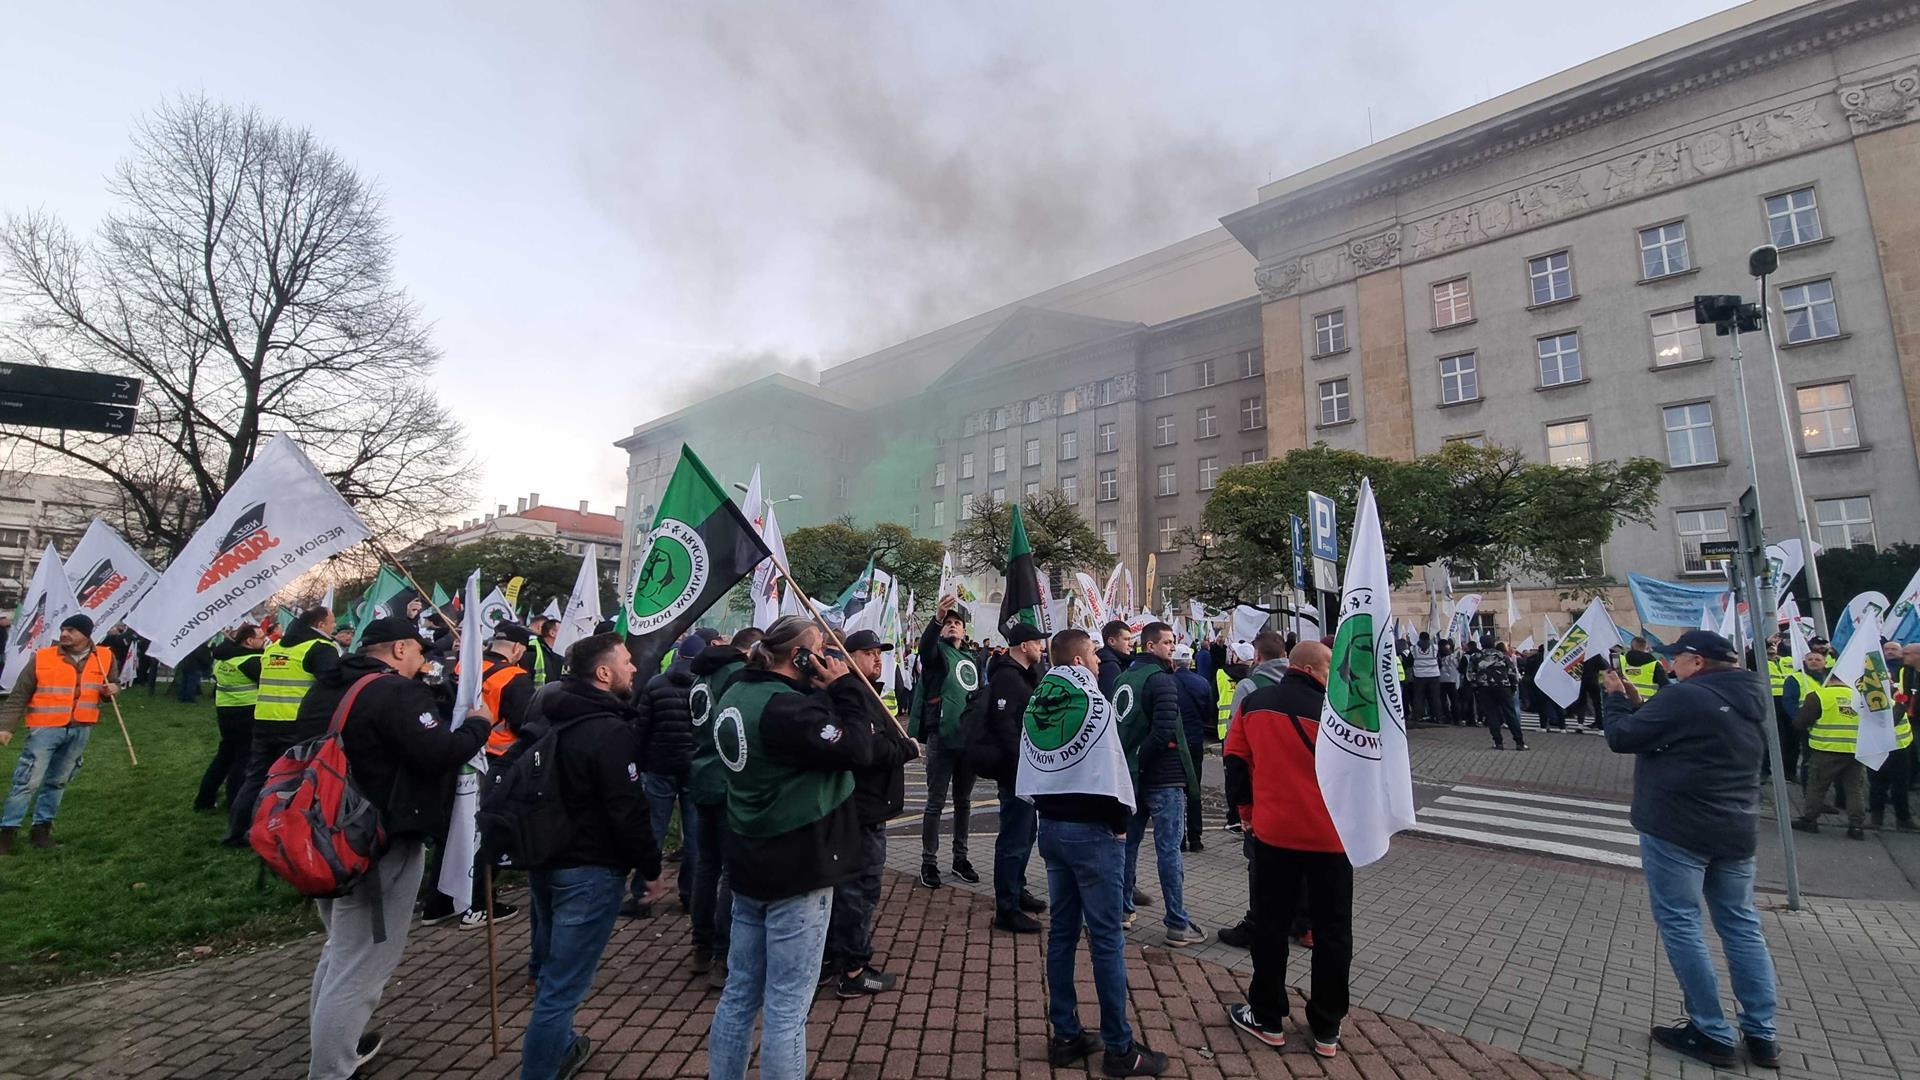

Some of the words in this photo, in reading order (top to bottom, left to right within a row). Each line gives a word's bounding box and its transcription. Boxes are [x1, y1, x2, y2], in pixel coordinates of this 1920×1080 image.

[1315, 501, 1331, 550] P
[1060, 697, 1105, 762] DOŁOWYCH
[1326, 714, 1382, 751] DOŁOW
